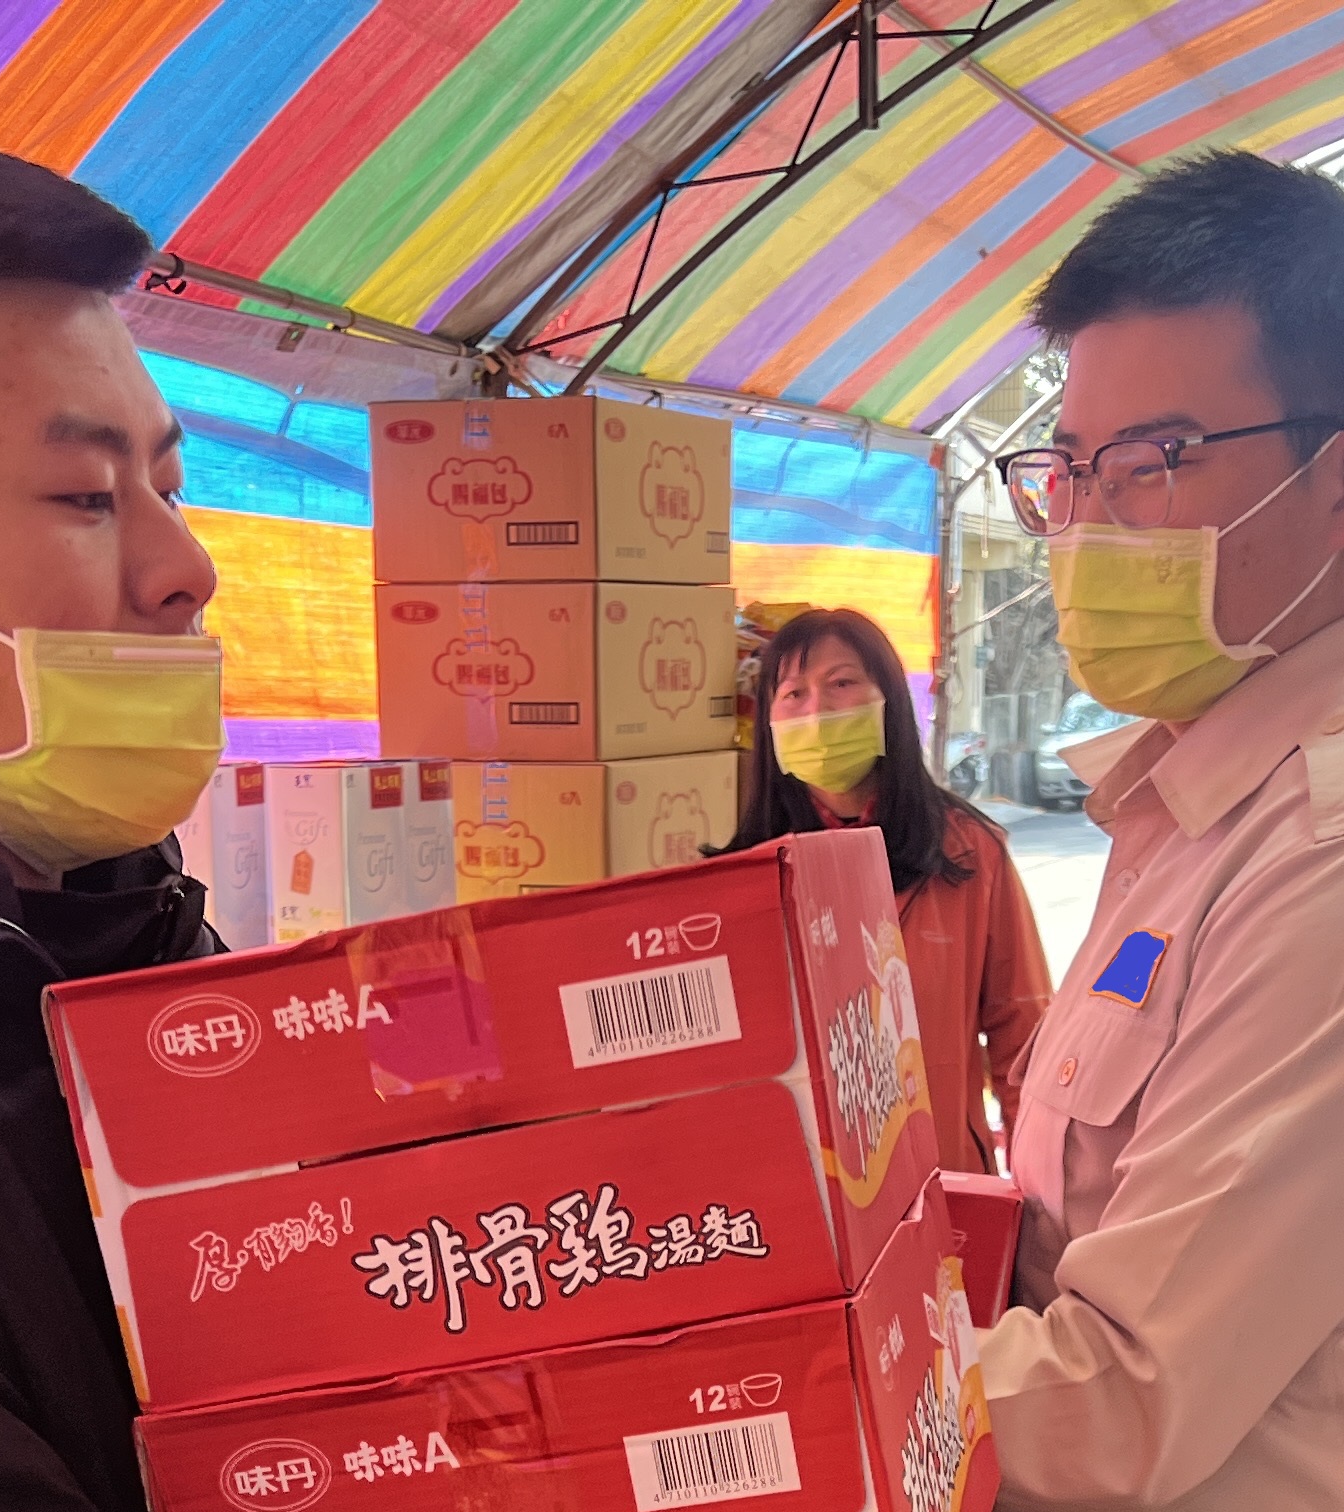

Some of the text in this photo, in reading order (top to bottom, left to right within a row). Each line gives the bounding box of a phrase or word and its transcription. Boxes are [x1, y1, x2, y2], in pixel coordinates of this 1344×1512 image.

[626, 927, 665, 960] 12
[162, 986, 393, 1057] 味丹 味味A
[602, 1029, 713, 1055] 710110 226288
[689, 1385, 726, 1413] 12
[235, 1432, 460, 1498] 味丹 味味A
[667, 1477, 777, 1501] 710110 226288
